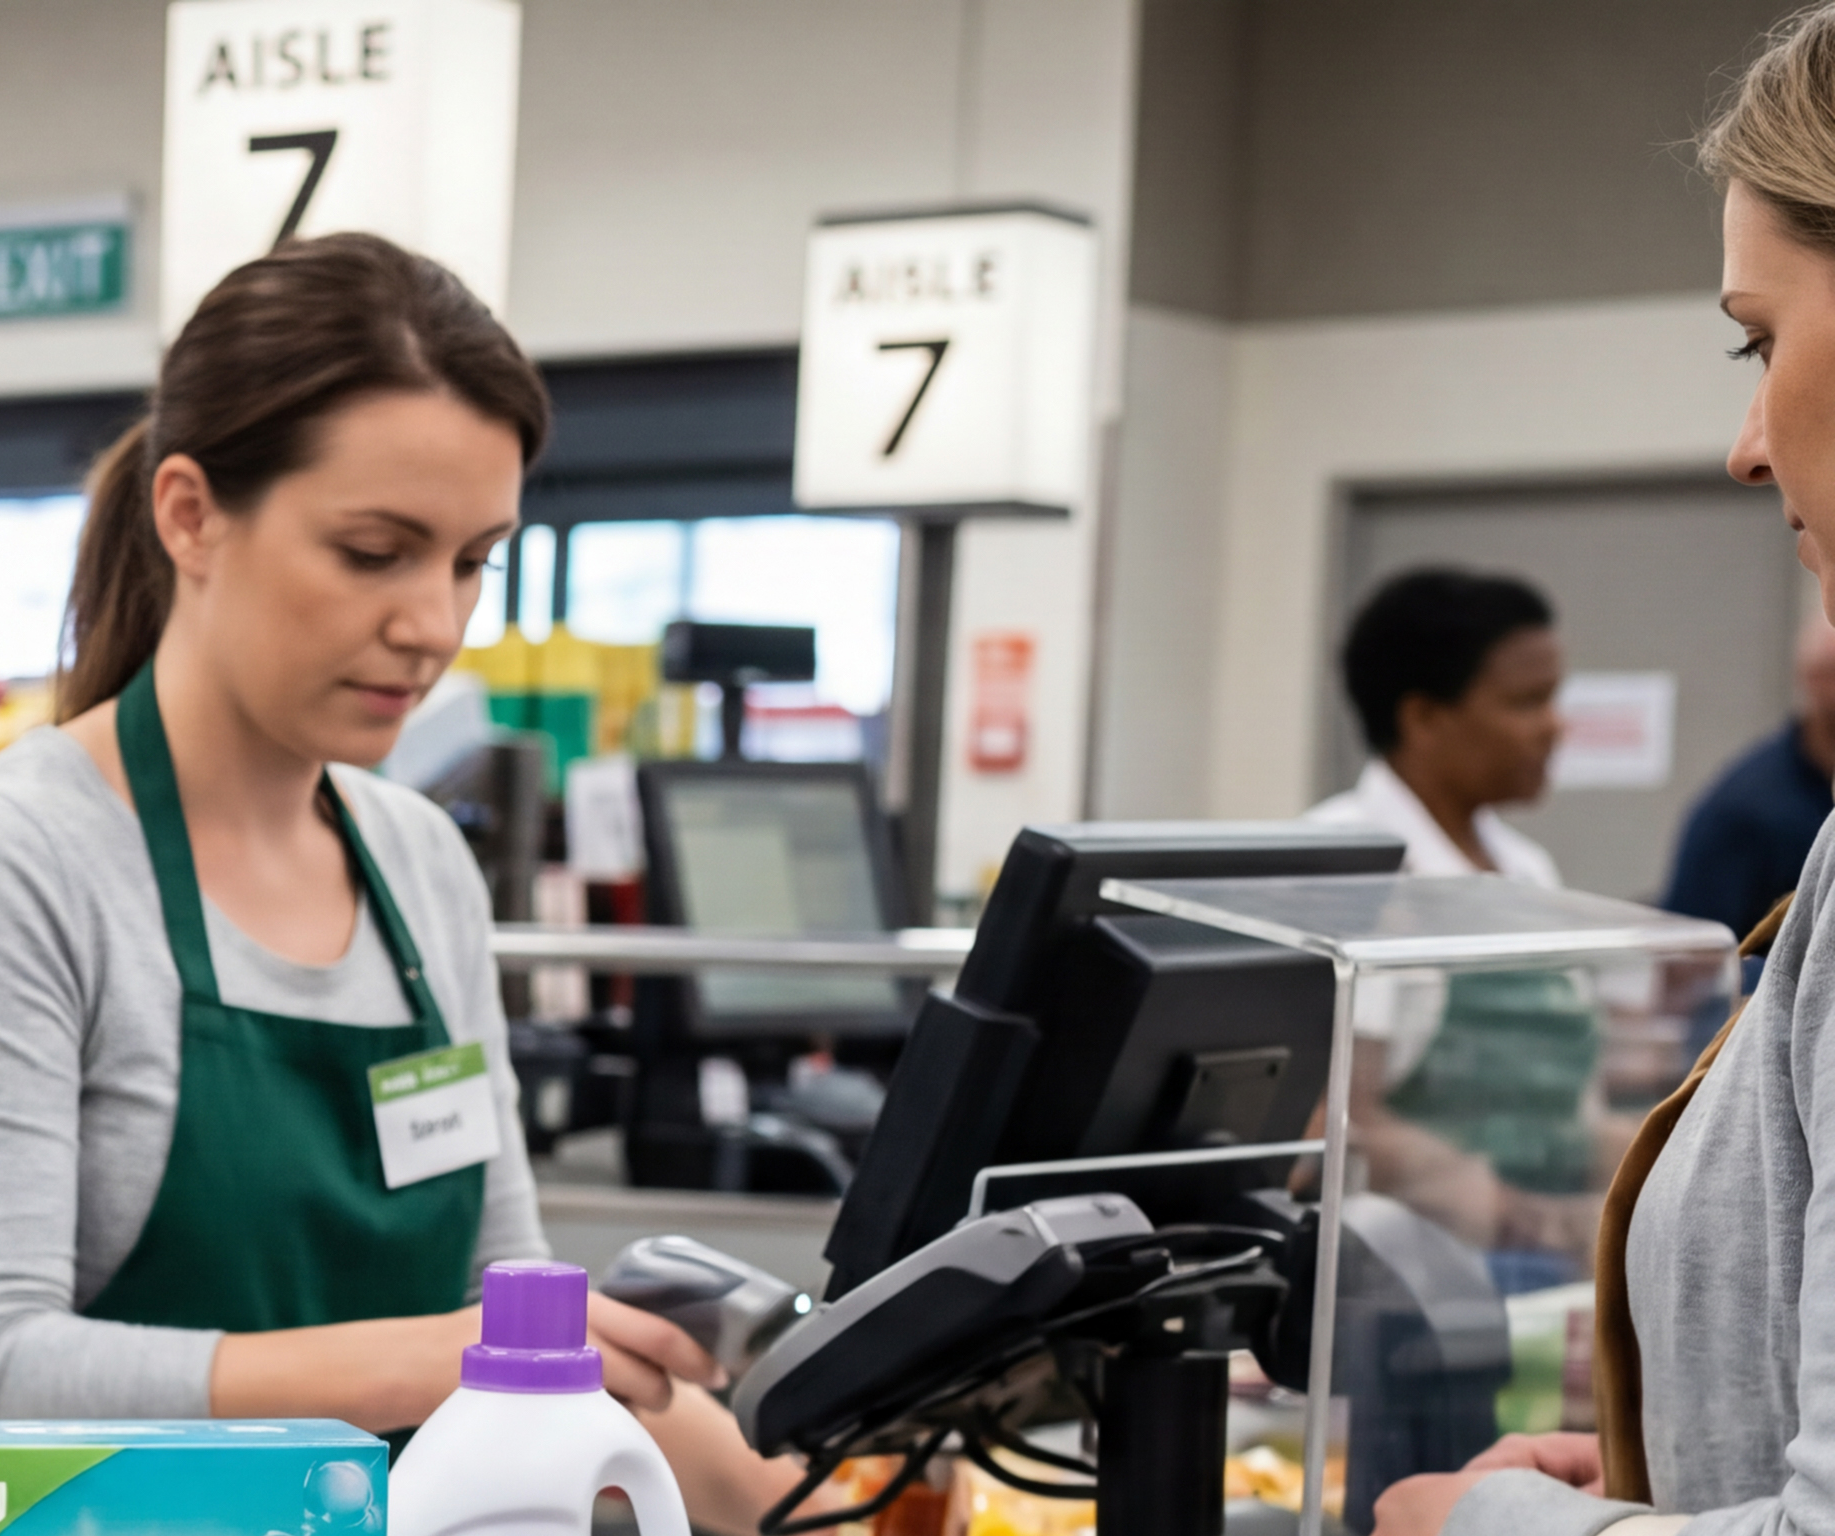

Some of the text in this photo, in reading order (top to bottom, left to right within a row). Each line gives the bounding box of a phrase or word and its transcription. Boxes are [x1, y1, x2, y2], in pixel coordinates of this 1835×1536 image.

[198, 22, 390, 96] AISLE
[248, 129, 338, 257] 7
[876, 340, 950, 456] 7
